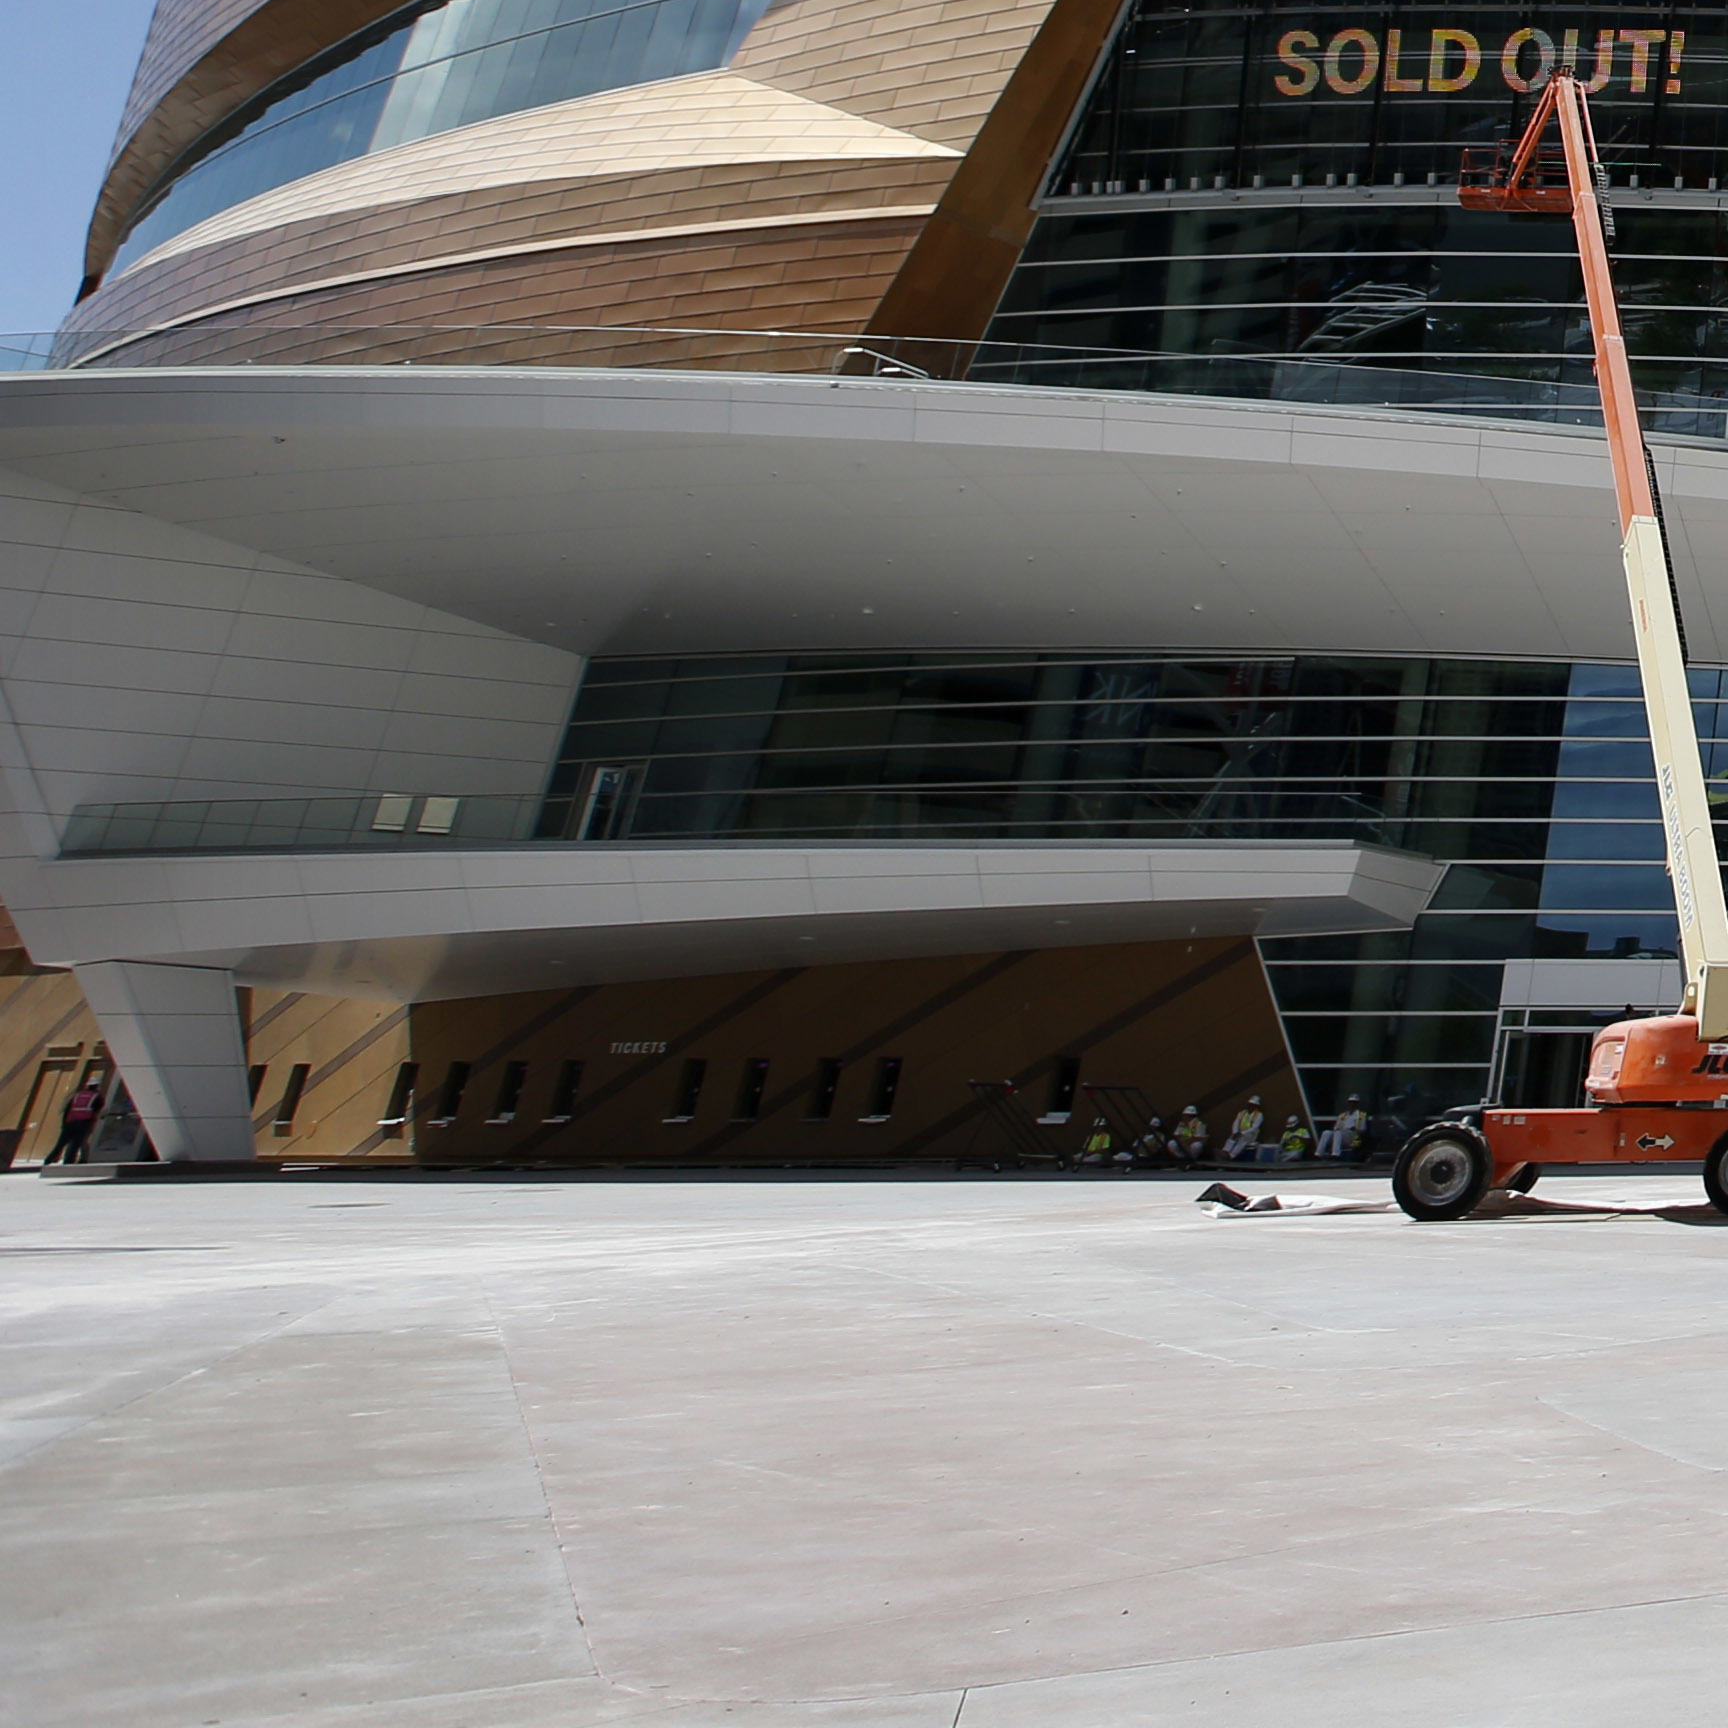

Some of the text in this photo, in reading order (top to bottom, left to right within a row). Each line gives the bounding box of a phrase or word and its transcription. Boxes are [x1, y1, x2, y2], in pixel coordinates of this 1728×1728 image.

[1273, 28, 1482, 97] SOLD
[1500, 27, 1687, 95] OUT!
[609, 1041, 667, 1054] TICKETS
